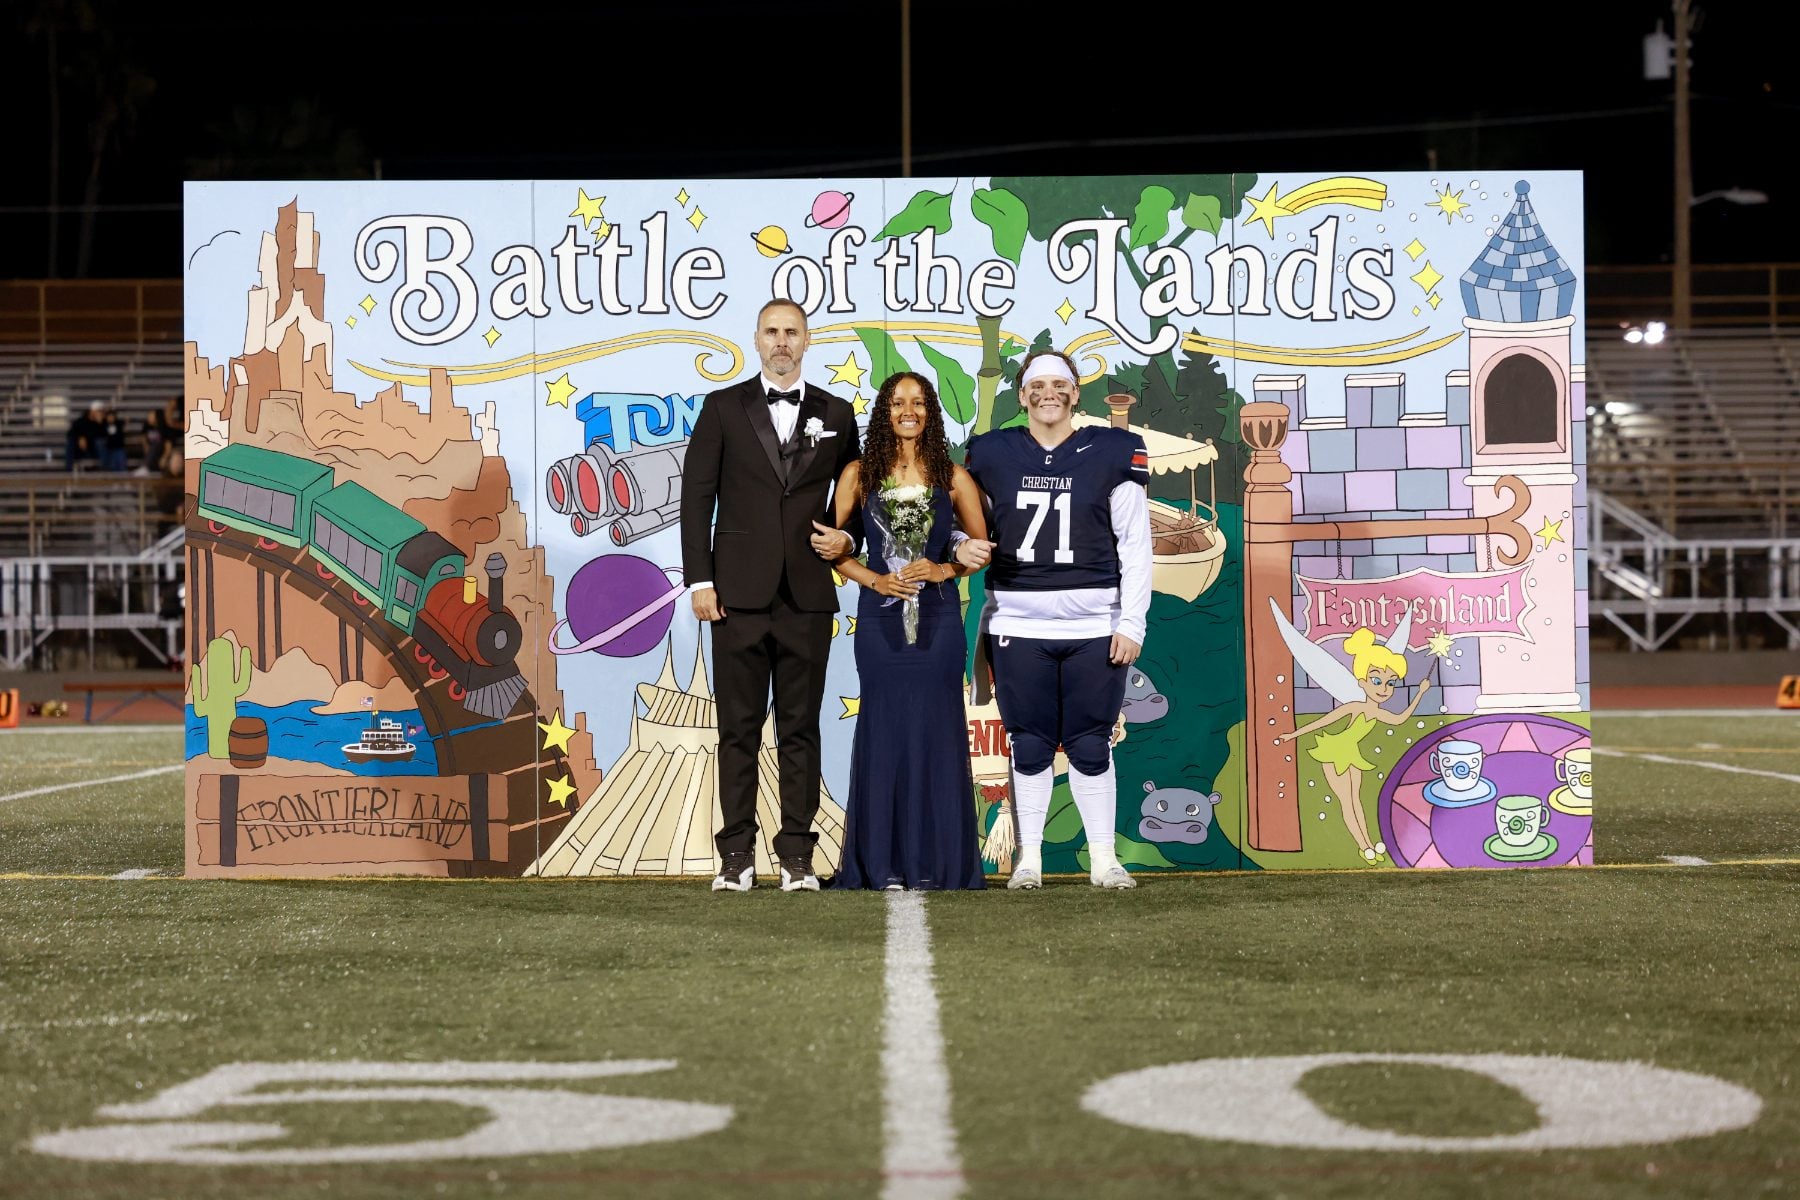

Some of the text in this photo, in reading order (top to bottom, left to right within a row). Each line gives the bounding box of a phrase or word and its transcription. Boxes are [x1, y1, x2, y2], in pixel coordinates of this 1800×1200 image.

[355, 211, 1396, 356] Battle of the Lands
[1022, 476, 1073, 490] CHRISTIAN
[1044, 455, 1053, 465] C
[1016, 491, 1074, 564] 71
[1314, 581, 1513, 631] Fantasyland
[1782, 680, 1800, 699] 4
[236, 786, 470, 852] FRONTIERLAND
